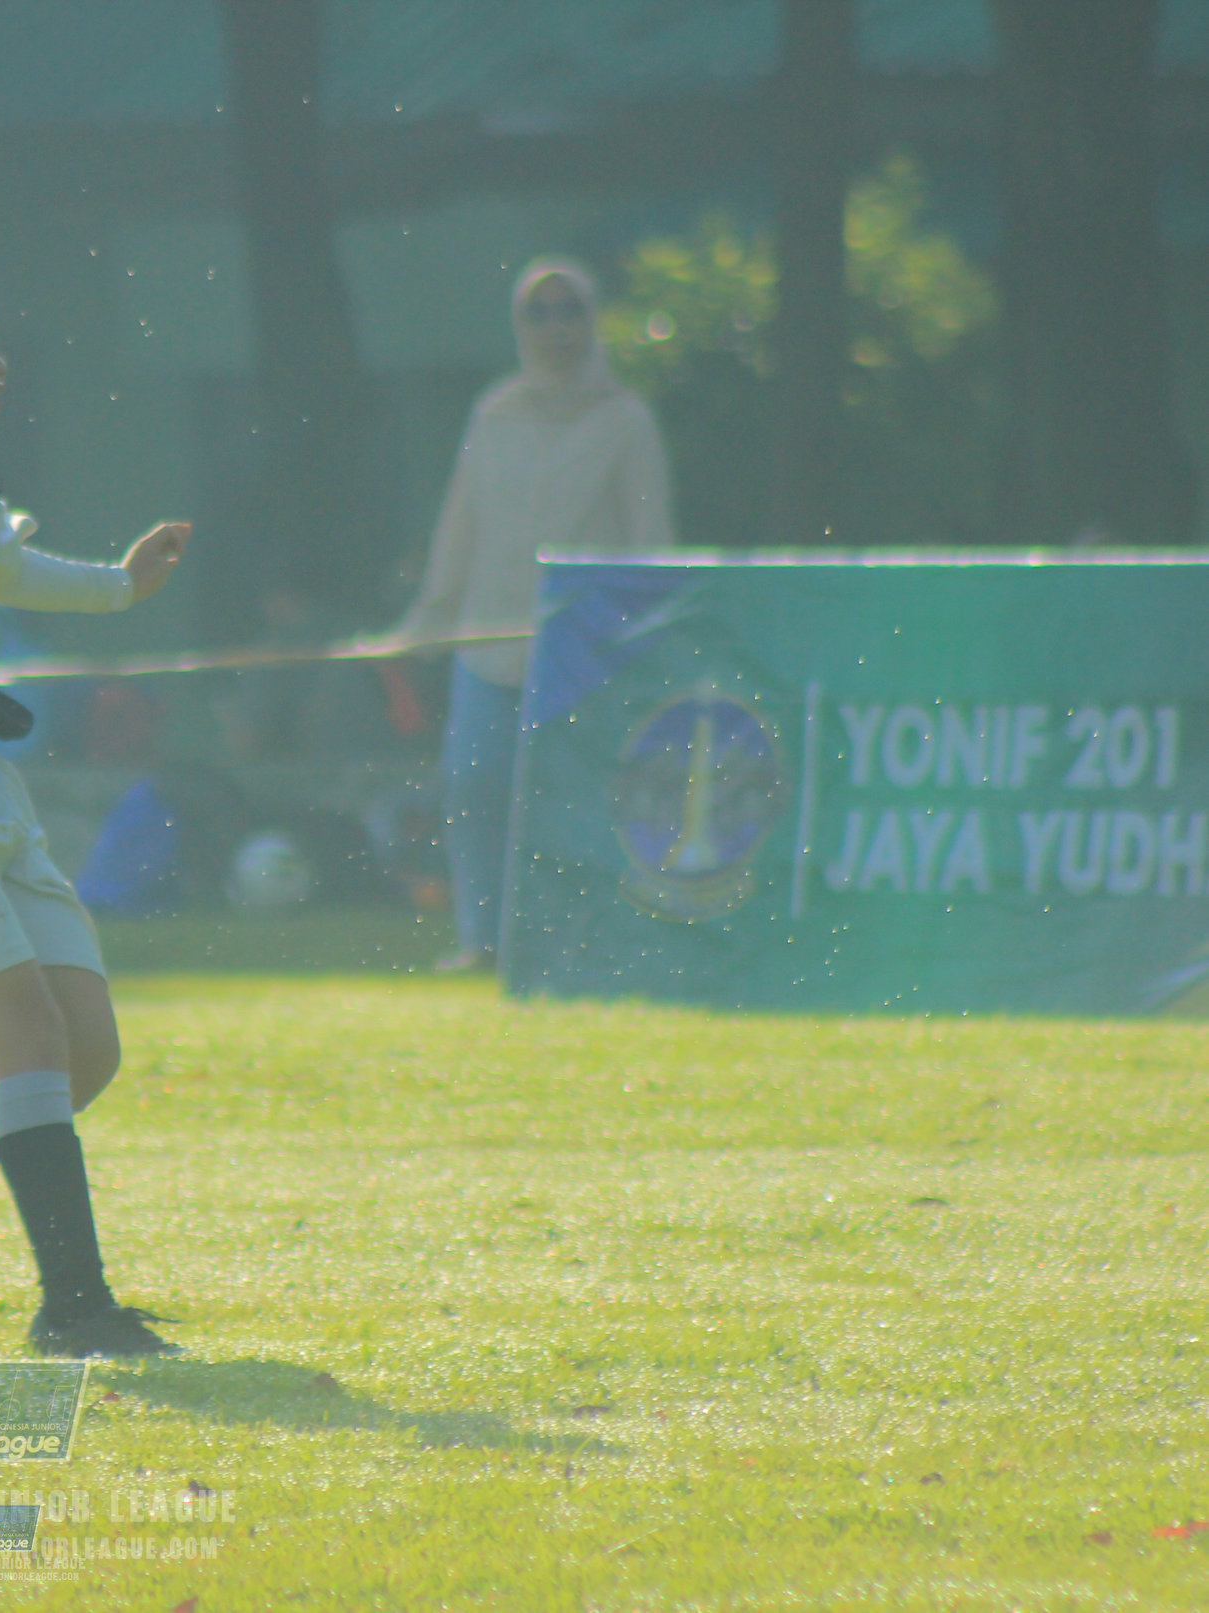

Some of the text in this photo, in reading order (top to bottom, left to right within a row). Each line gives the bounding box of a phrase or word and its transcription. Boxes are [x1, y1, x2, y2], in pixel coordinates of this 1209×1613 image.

[839, 706, 1179, 790] YONIF 201
[824, 811, 1209, 896] JAYA YUDH
